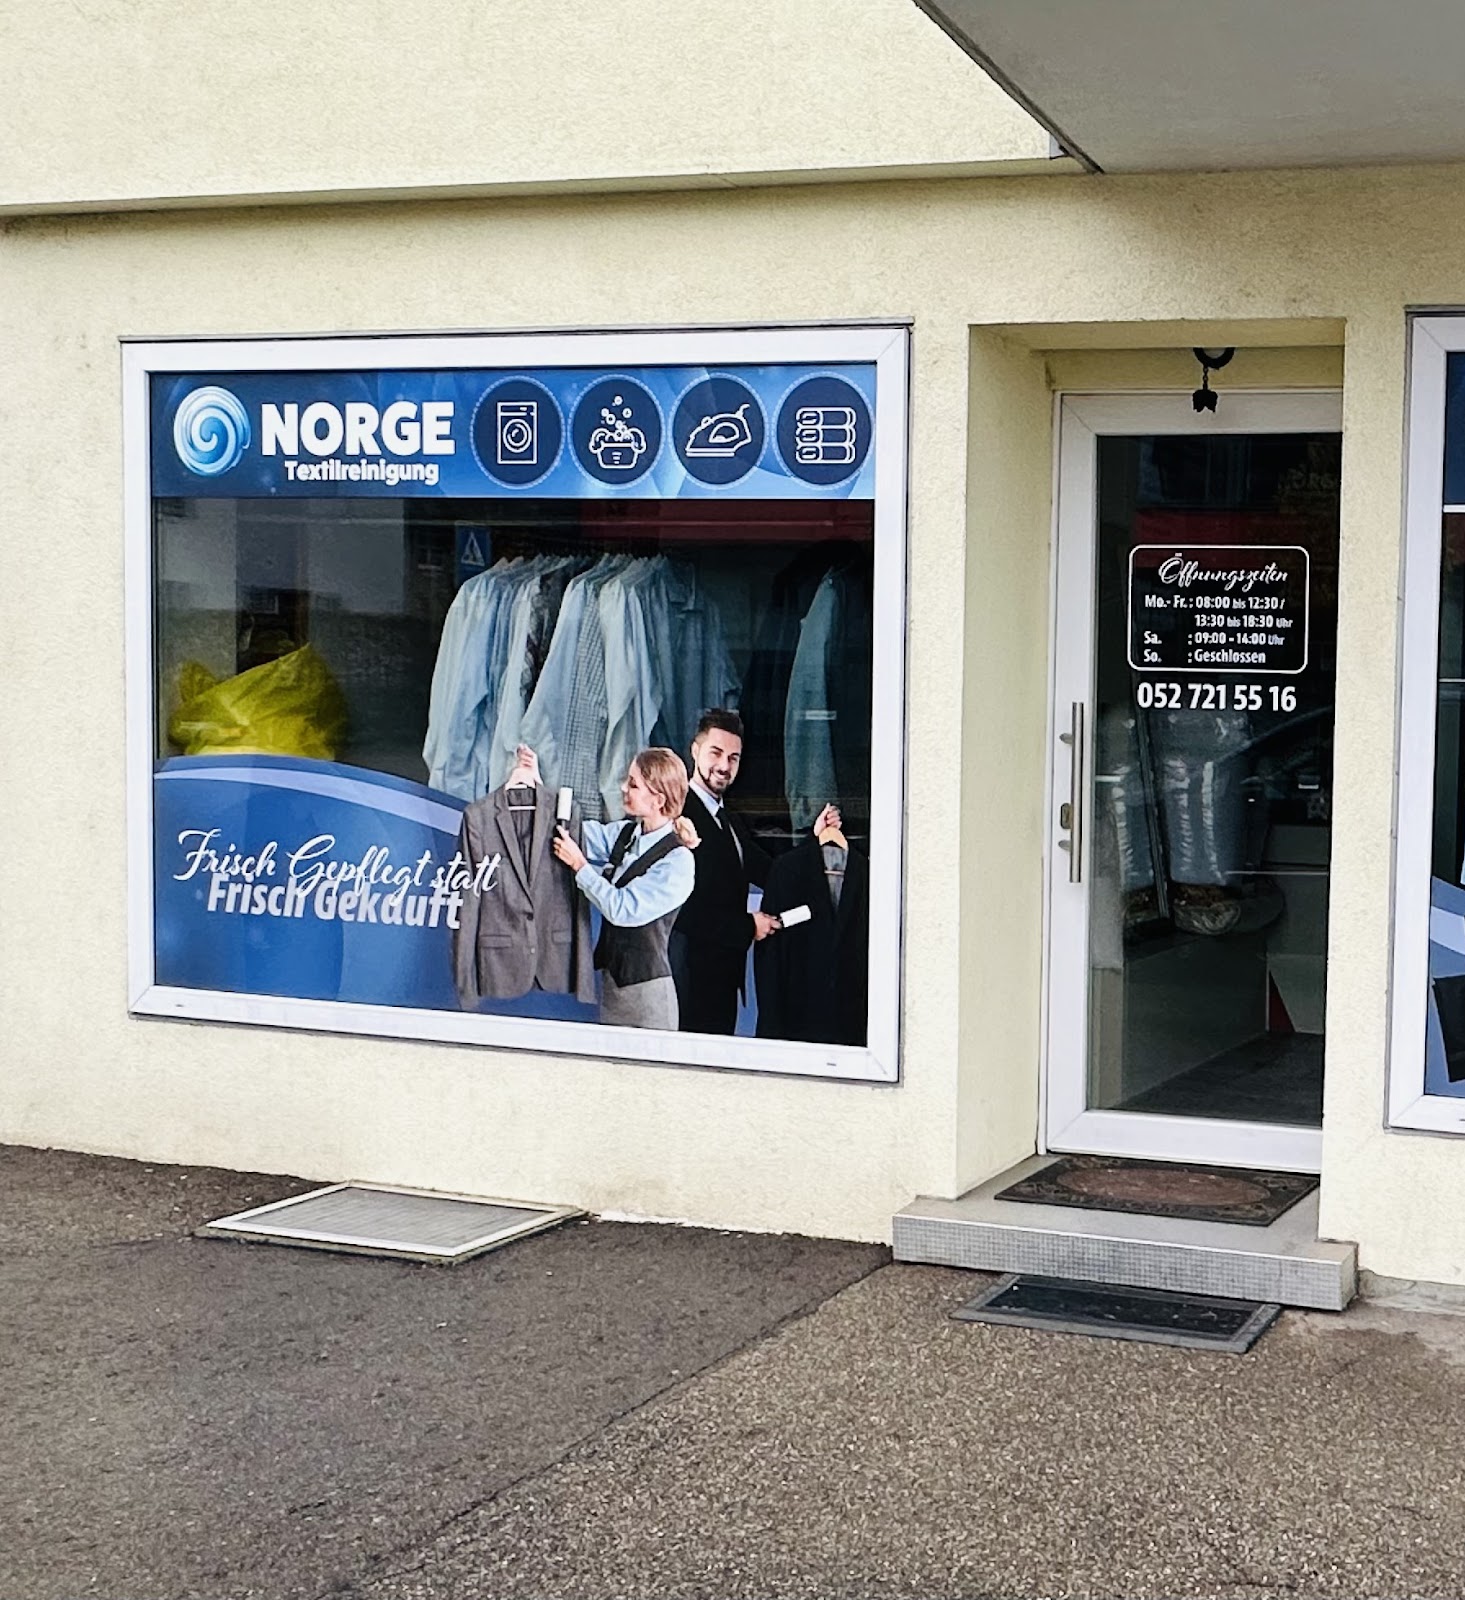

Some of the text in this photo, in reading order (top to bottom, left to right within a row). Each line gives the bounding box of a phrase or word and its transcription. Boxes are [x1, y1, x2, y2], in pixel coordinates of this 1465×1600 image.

[260, 400, 456, 458] NORGE
[284, 459, 440, 486] Textilreinigung
[1157, 552, 1289, 593] Öffnungszeiten
[1195, 596, 1230, 610] 08:00
[1232, 598, 1246, 610] bis
[1194, 613, 1294, 629] 13:30 bis 18:30 Uhr
[1143, 630, 1162, 645] Sa.
[1194, 631, 1226, 645] 09:00
[1236, 632, 1267, 646] 14:00
[1268, 633, 1286, 646] Uhr
[1143, 648, 1162, 663] So.
[1194, 648, 1267, 664] Geschlossen
[1136, 682, 1297, 712] 052 721 55 16
[173, 828, 502, 907] Frisch Gepflegt statt
[206, 872, 465, 930] Frisch Gekauft
